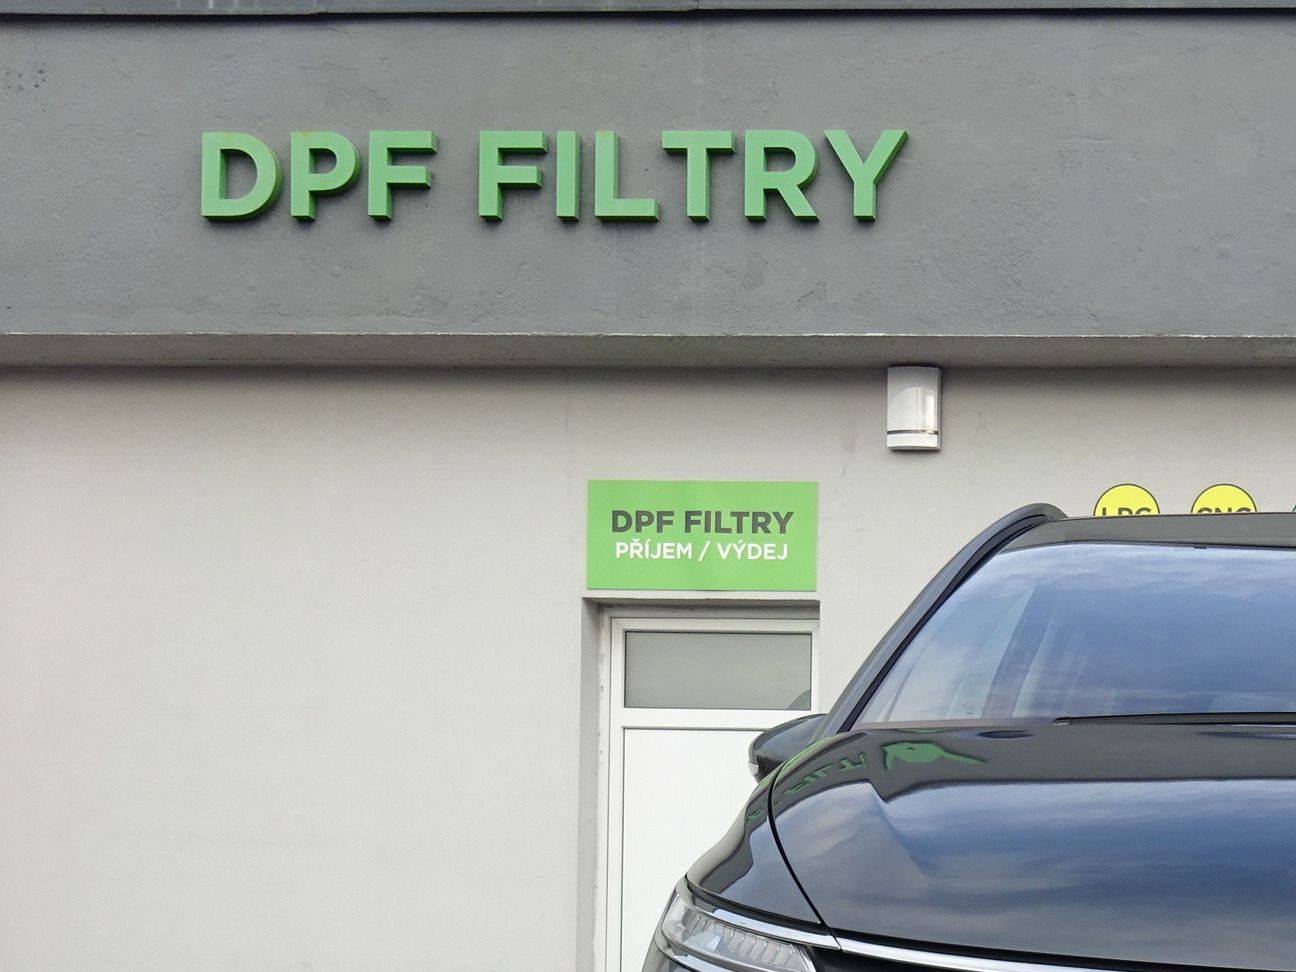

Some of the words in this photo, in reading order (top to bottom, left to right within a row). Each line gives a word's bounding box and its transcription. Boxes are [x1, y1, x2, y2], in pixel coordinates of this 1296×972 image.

[201, 130, 437, 220] DPF
[478, 129, 908, 221] FILTRY
[611, 509, 675, 533] DPF
[684, 510, 795, 534] FILTRY
[615, 538, 692, 559] PŘÍJEM
[717, 539, 789, 560] VÝDEJ
